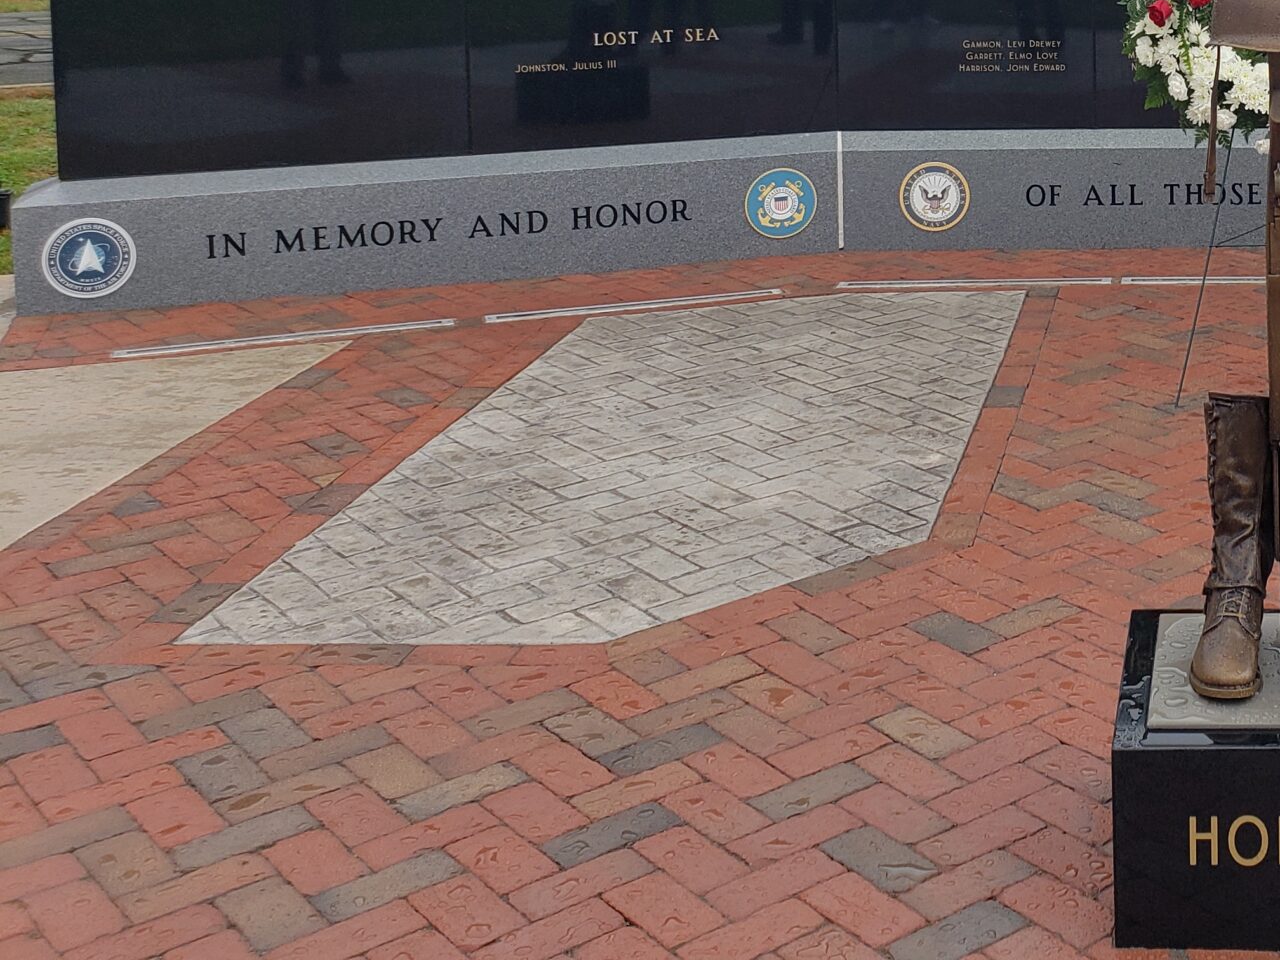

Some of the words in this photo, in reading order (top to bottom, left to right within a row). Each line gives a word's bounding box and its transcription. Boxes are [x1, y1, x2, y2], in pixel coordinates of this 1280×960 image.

[594, 32, 638, 45] LOST
[651, 30, 673, 43] AT
[685, 29, 719, 41] SEA
[1007, 39, 1026, 48] LEVI
[1029, 39, 1061, 48] DREWEY
[572, 61, 603, 71] JULIUS
[606, 59, 617, 69] III
[1026, 185, 1061, 206] OF
[1083, 184, 1143, 206] ALL
[1164, 183, 1261, 205] THOSE
[206, 233, 246, 259] IN
[274, 218, 443, 253] MEMORY
[468, 211, 548, 238] AND
[571, 200, 692, 230] HONOR
